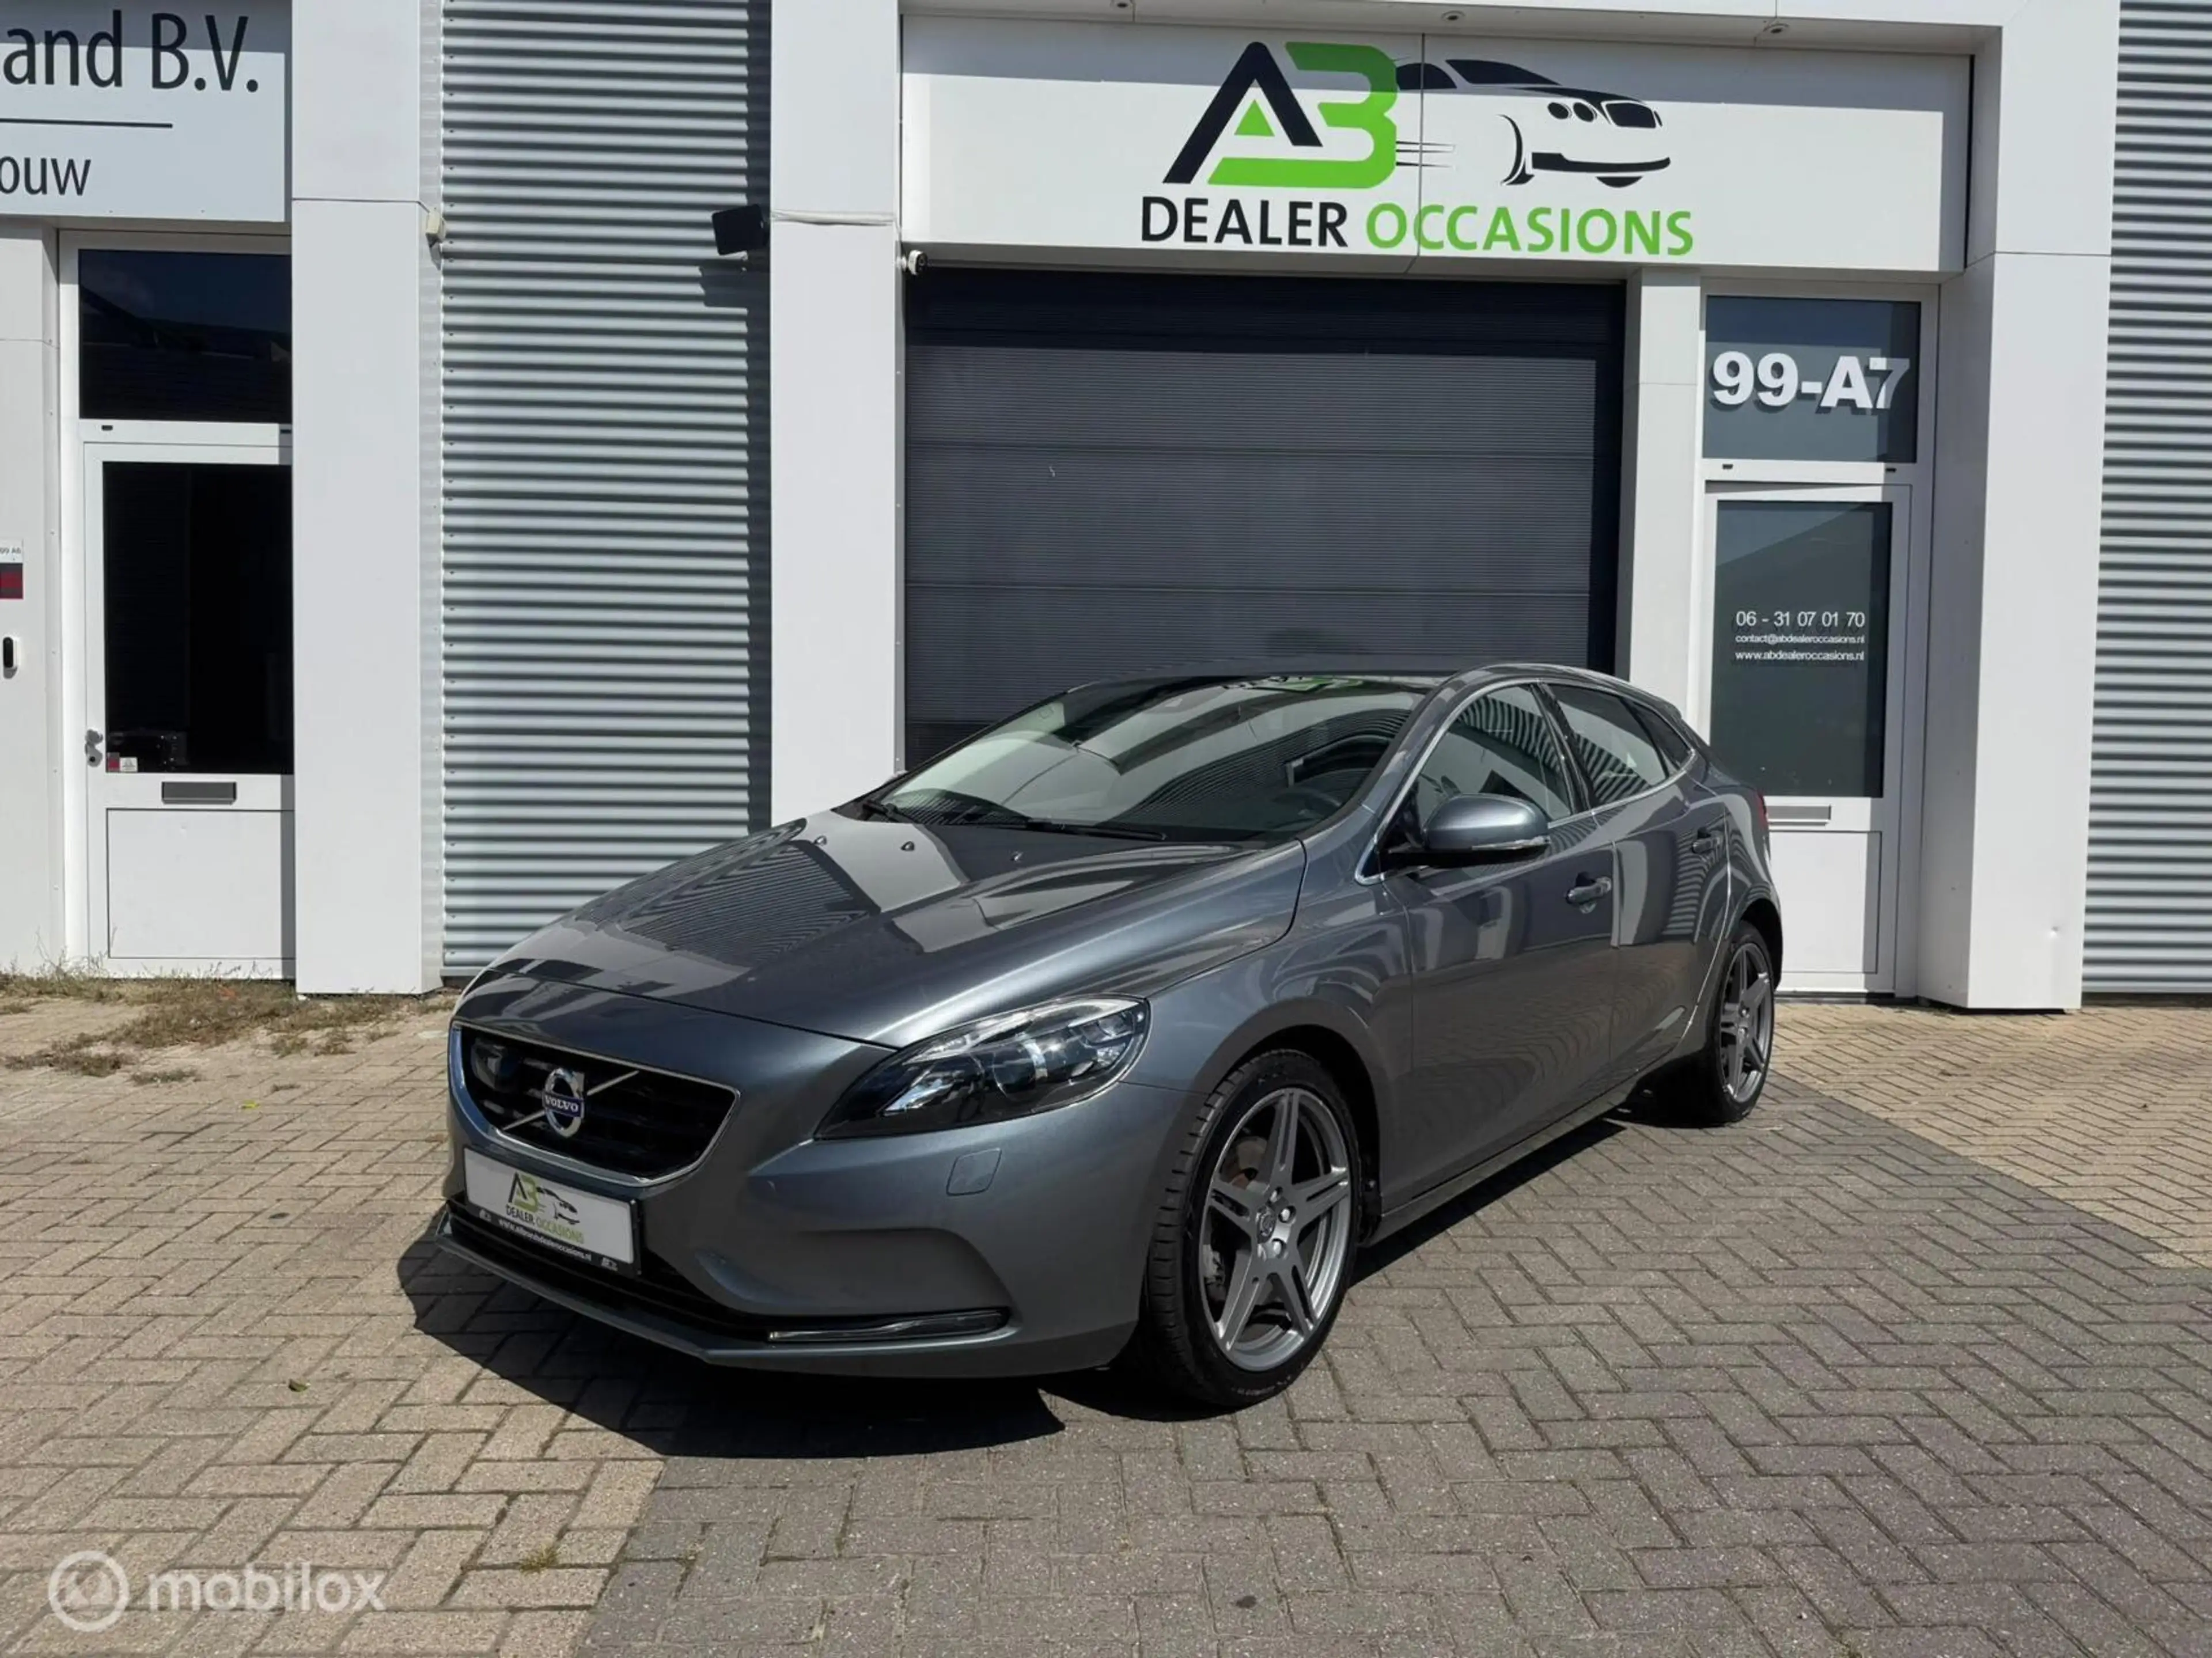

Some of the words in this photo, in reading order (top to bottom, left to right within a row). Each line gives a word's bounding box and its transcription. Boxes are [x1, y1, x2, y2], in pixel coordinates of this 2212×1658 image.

[151, 13, 259, 93] B.V.
[1141, 196, 1349, 248] DEALER
[1366, 202, 1694, 256] OCCASIONS
[1713, 351, 1910, 409] 99-A7
[1736, 610, 1757, 627] 06
[1774, 611, 1790, 627] 31
[1797, 611, 1816, 627] 07
[1822, 612, 1838, 627] 01
[1846, 612, 1865, 627] 70
[1735, 633, 1865, 645] contact@abdealeroccasions.nl
[1735, 649, 1864, 661] www.abdealeroccasions.nl
[545, 1095, 579, 1112] VOLVO
[506, 1204, 535, 1226] DEALER
[535, 1216, 585, 1245] OCCASIONS
